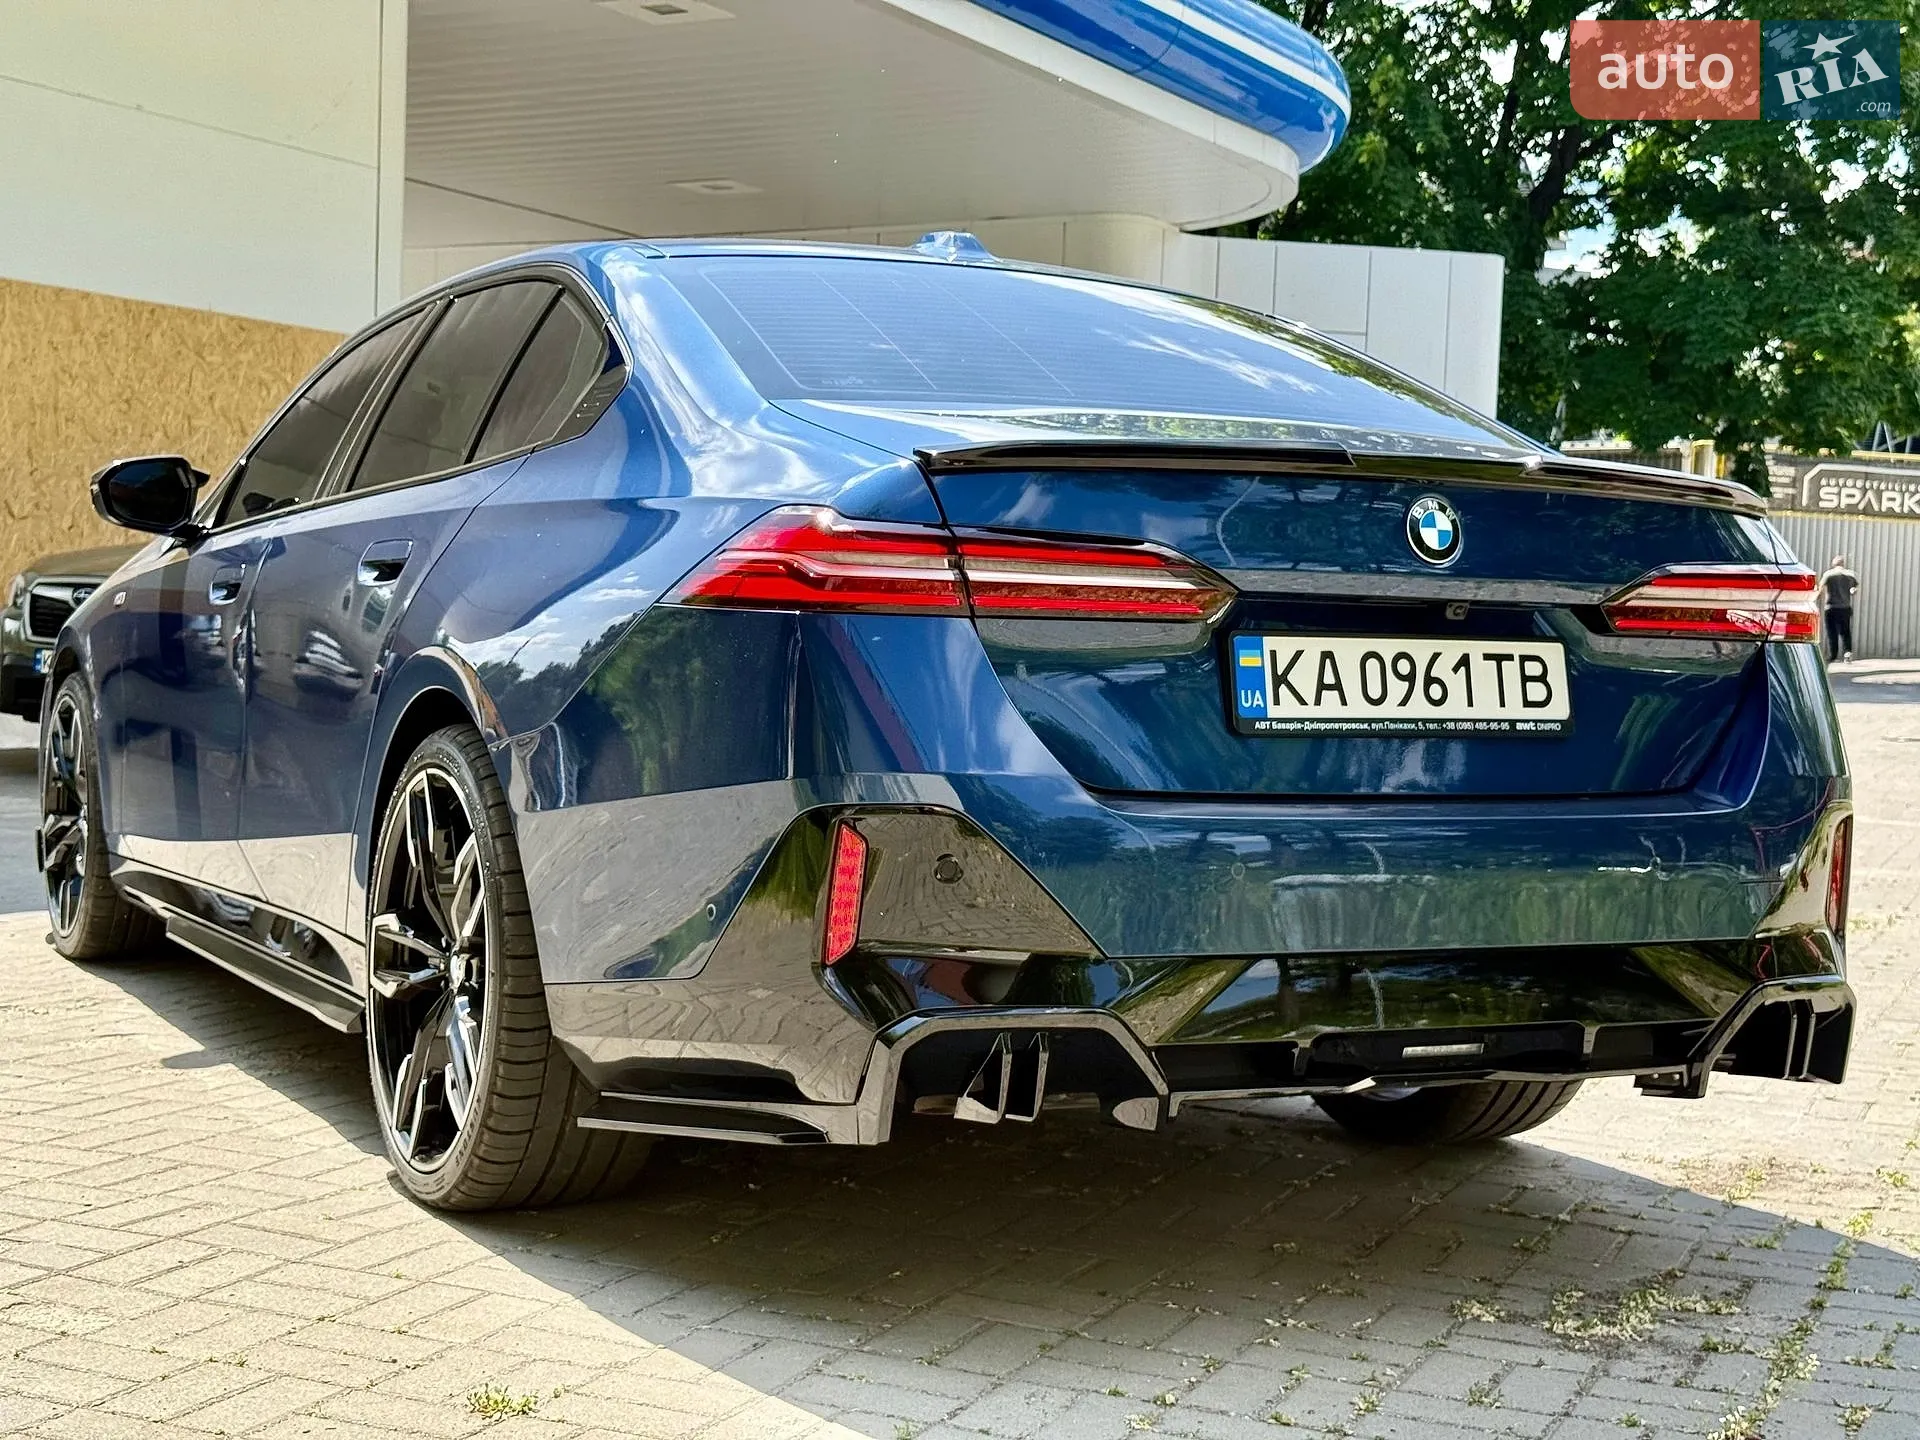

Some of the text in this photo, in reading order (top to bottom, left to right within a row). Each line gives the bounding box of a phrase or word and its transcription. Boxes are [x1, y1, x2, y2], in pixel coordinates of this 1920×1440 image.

[1412, 500, 1456, 521] BMW
[1269, 649, 1553, 708] KA 0961 TB
[1241, 689, 1264, 708] UA
